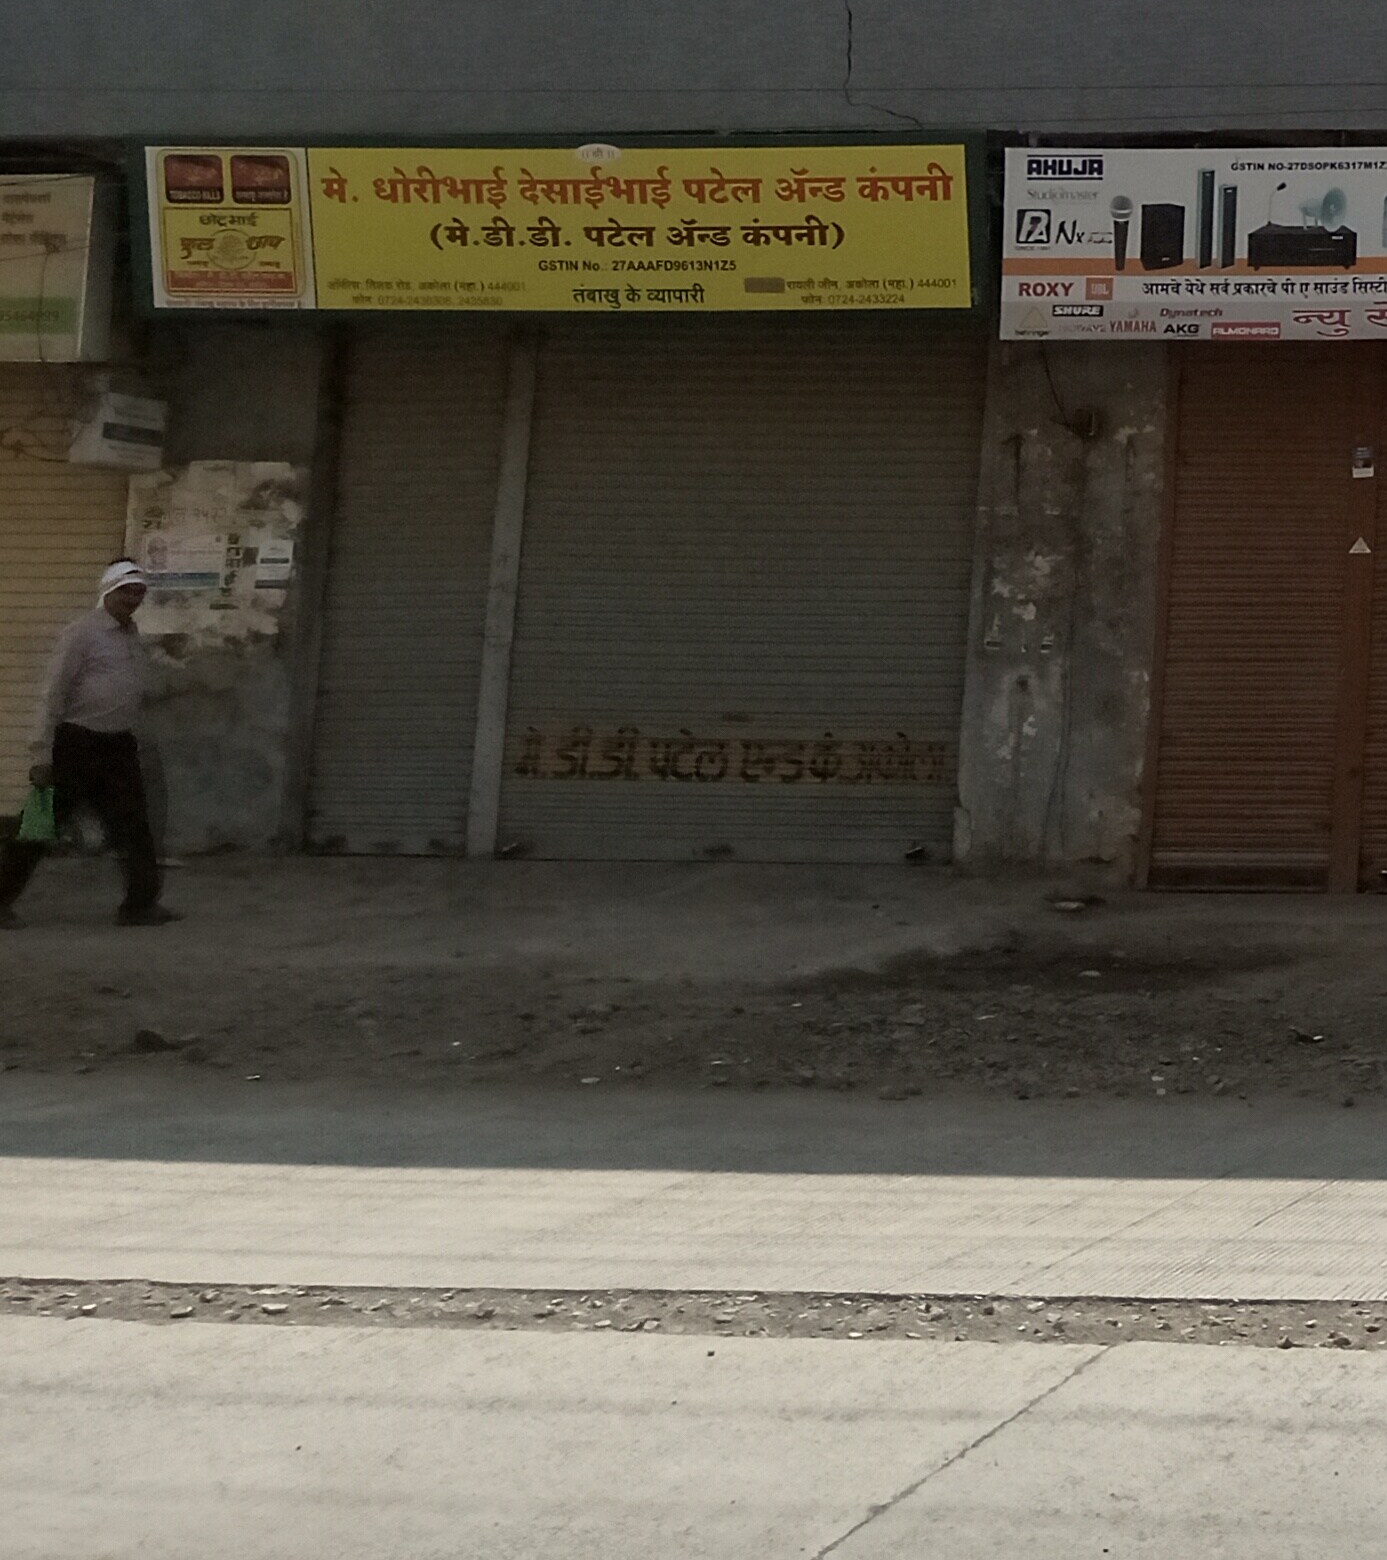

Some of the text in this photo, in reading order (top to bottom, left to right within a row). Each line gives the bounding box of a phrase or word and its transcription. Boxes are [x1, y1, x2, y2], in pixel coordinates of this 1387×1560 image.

[1027, 158, 1104, 176] AHUJA
[1230, 160, 1265, 172] GSTIN
[321, 166, 360, 204] मे.
[372, 165, 508, 210] धोरीभाई
[518, 165, 673, 210] देसाईभाई
[682, 167, 763, 205] पटेल
[856, 161, 954, 203] कंपनी
[584, 217, 656, 248] पटेल
[740, 214, 847, 250] कंपनी)
[538, 260, 579, 272] GSTIN
[611, 259, 737, 272] 27AAAFD9613N1Z5
[626, 284, 641, 304] के
[646, 284, 706, 305] व्यापारी
[1018, 282, 1075, 297] ROXY
[1209, 278, 1231, 296] सर्व
[1053, 305, 1102, 316] SHURE
[1160, 307, 1224, 319] Dynatech
[1109, 320, 1157, 333] YAMAHA
[1163, 324, 1201, 335] AKG
[1291, 309, 1352, 337] न्यु
